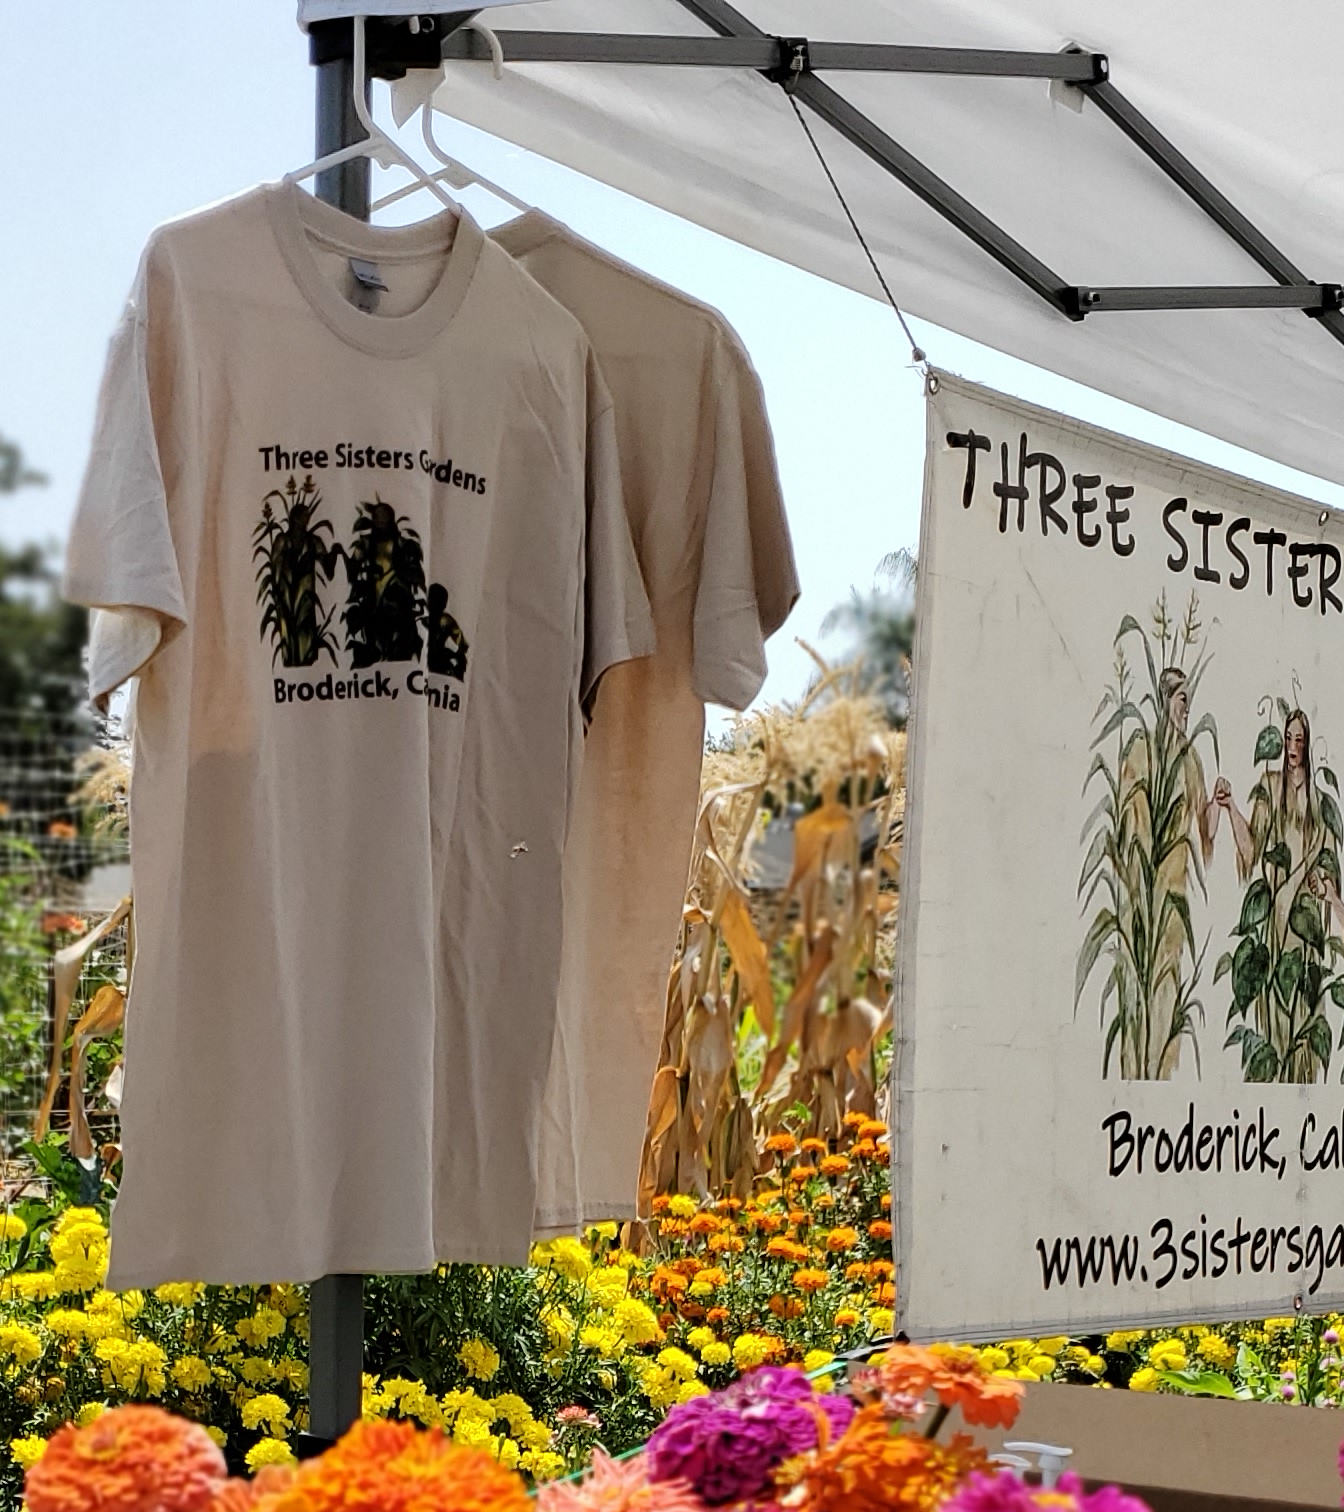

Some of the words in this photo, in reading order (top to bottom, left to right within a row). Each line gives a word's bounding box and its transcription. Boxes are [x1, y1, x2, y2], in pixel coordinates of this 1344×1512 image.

[258, 444, 329, 472] Three
[335, 443, 414, 470] Sisters
[419, 449, 487, 495] Grdens
[945, 428, 1135, 557] THREE
[273, 670, 399, 703] Broderick,
[1102, 1102, 1287, 1180] Broderick,
